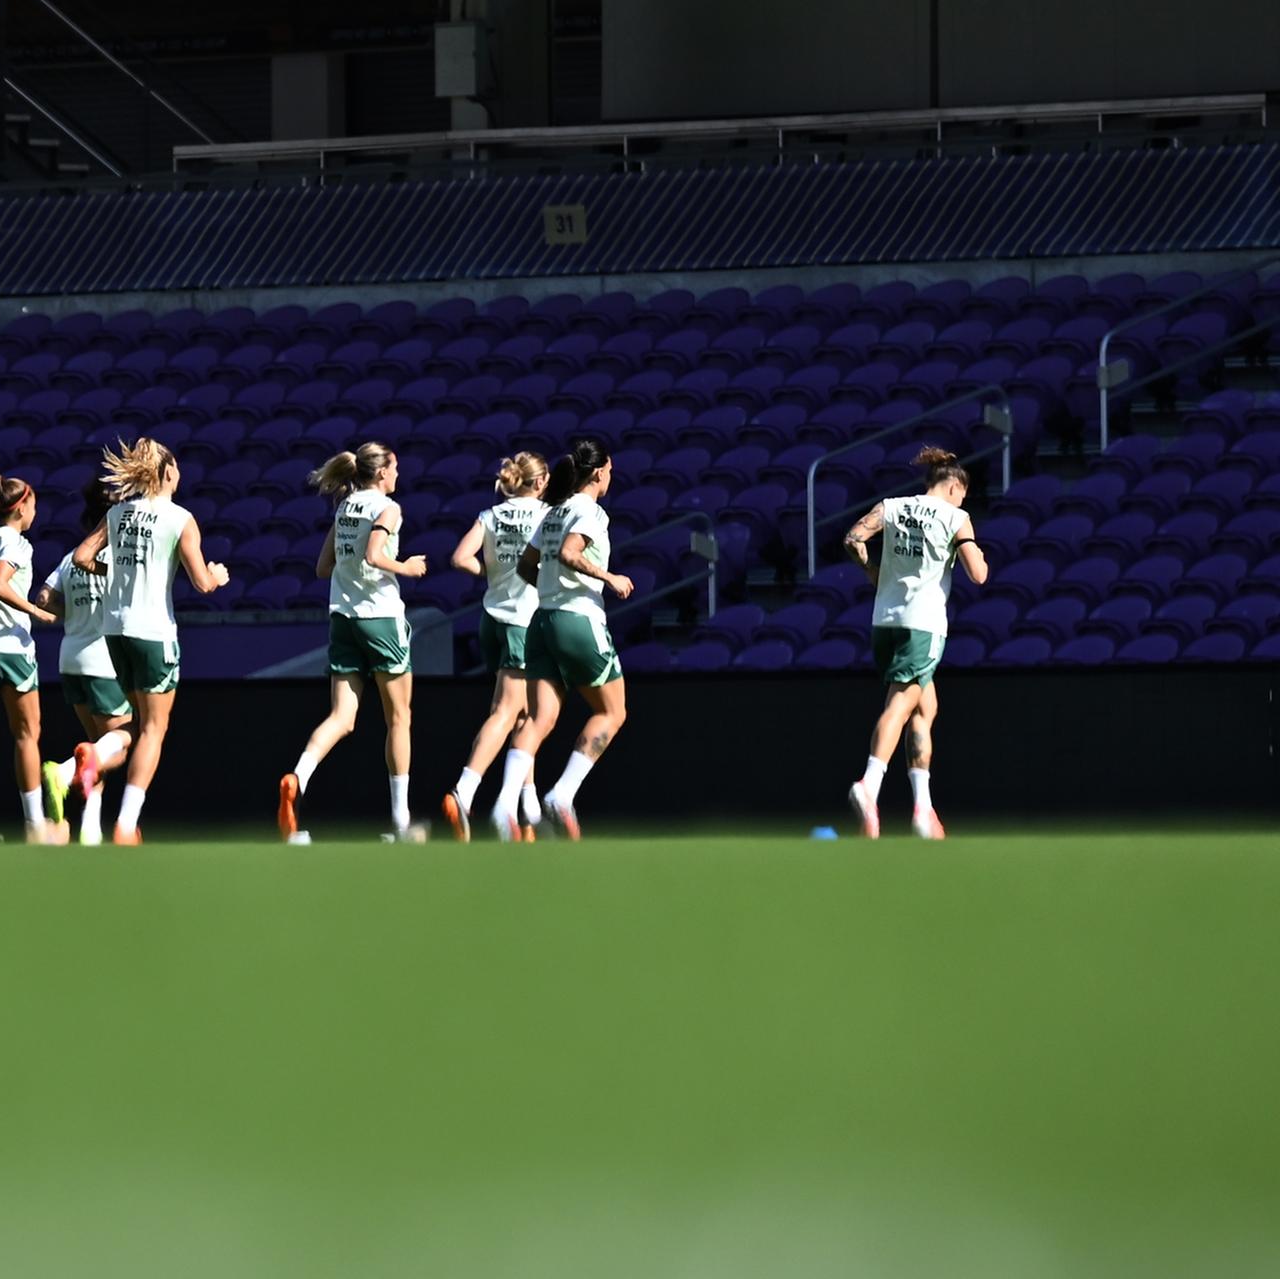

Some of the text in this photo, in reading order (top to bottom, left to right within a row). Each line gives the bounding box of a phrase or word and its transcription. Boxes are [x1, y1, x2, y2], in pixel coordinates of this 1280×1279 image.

[555, 214, 575, 235] 31
[344, 501, 364, 513] TIM
[914, 505, 937, 519] TIM
[135, 511, 158, 524] TIM
[509, 509, 533, 519] TIM
[338, 517, 359, 528] oste
[495, 522, 532, 533] Poste
[898, 515, 932, 530] Poste
[117, 522, 152, 538] Poste
[498, 551, 516, 563] eni
[894, 544, 912, 557] eni
[116, 553, 133, 567] eni
